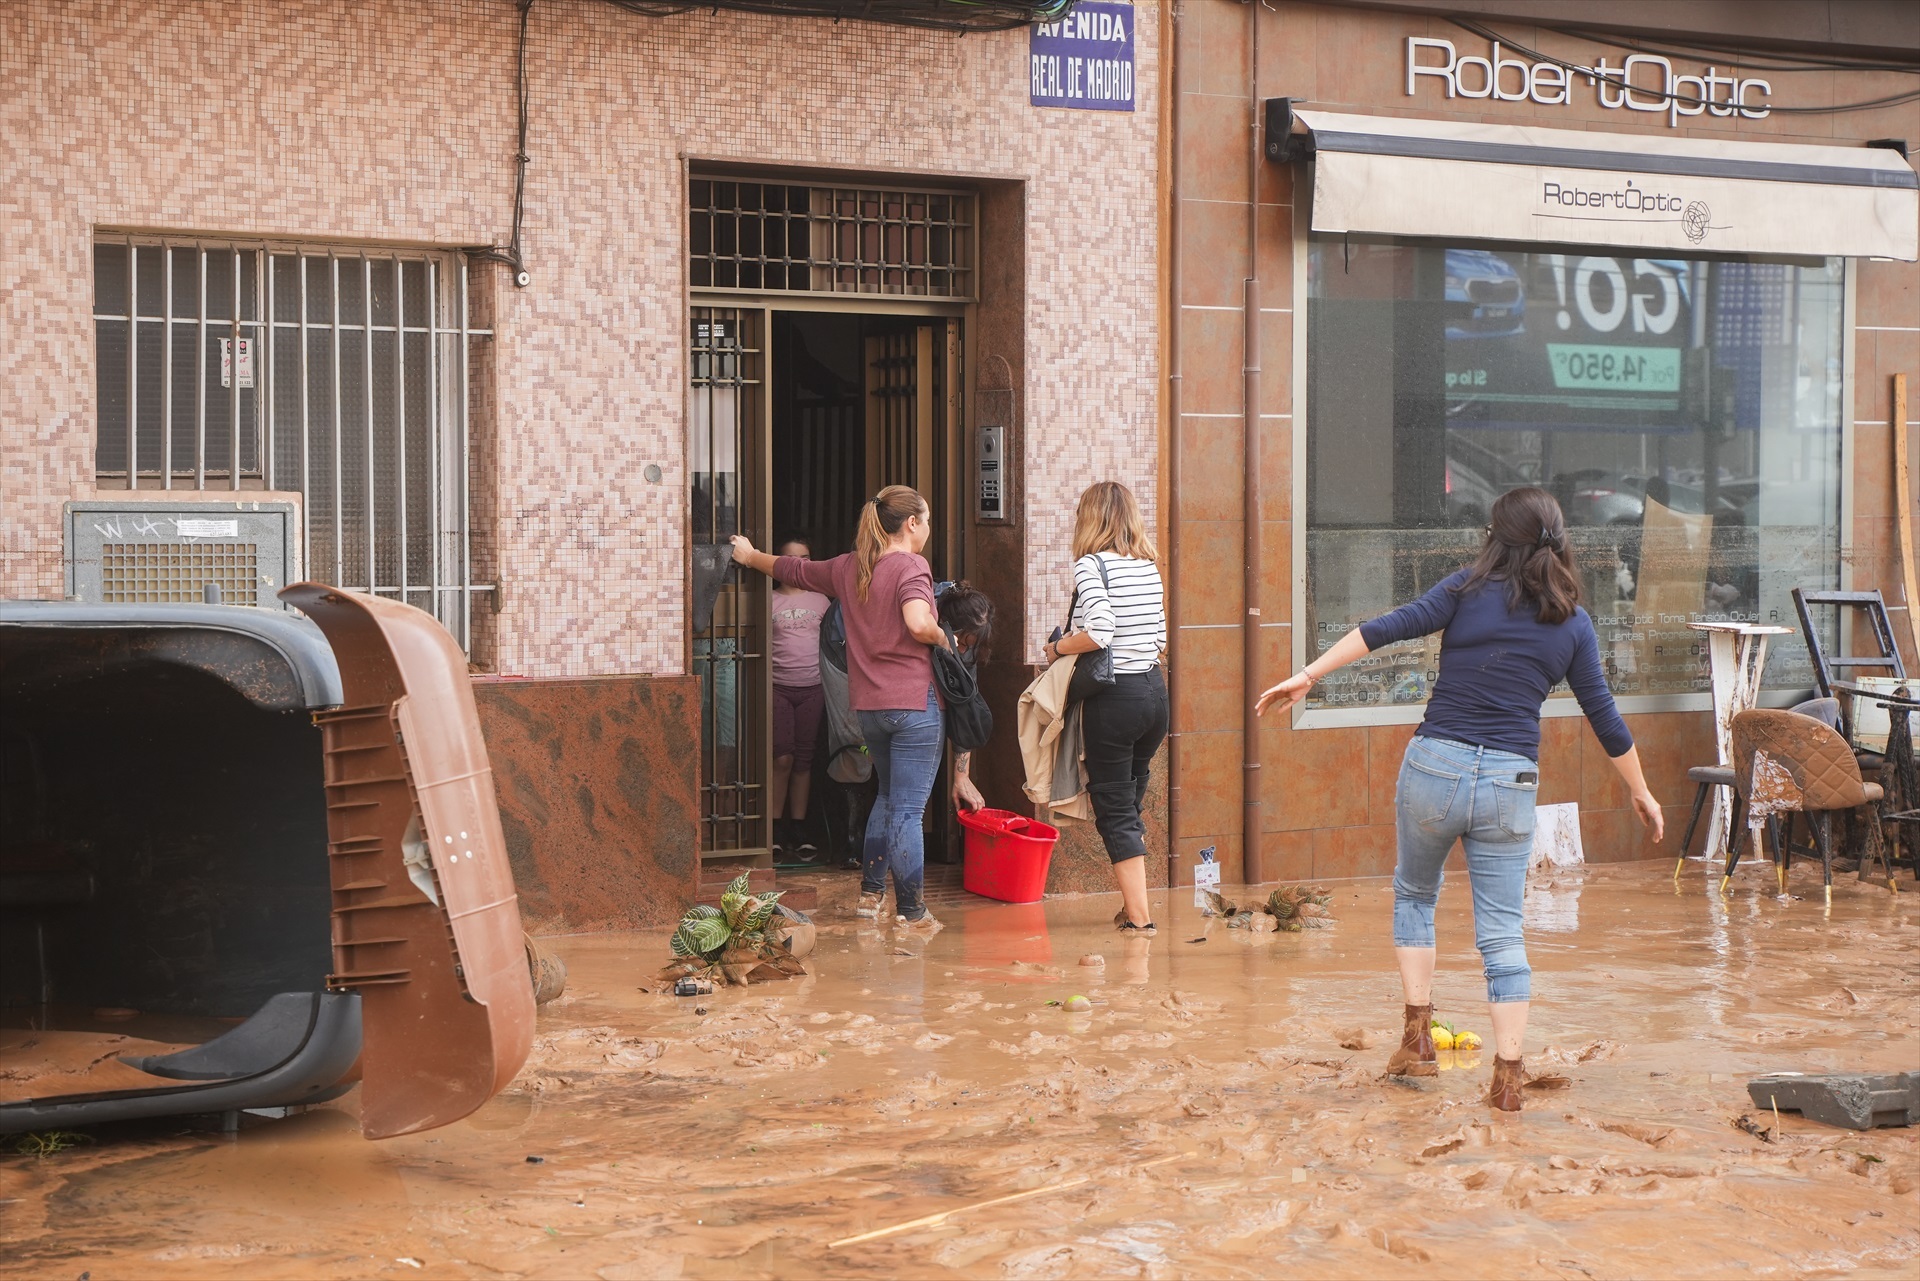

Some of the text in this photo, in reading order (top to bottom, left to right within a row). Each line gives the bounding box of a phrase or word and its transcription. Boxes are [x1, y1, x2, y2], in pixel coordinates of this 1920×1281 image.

[1032, 54, 1132, 101] REAL DE MADRID
[1406, 36, 1773, 127] RobertOptic
[1658, 612, 1686, 624] Toma
[1690, 611, 1727, 622] Tensión
[1608, 630, 1645, 642] Lentes
[1389, 653, 1419, 666] Vista
[1600, 648, 1641, 659] raduado
[1611, 680, 1640, 691] Visual
[1649, 679, 1689, 690] Servicio
[1394, 688, 1429, 700] Filtros
